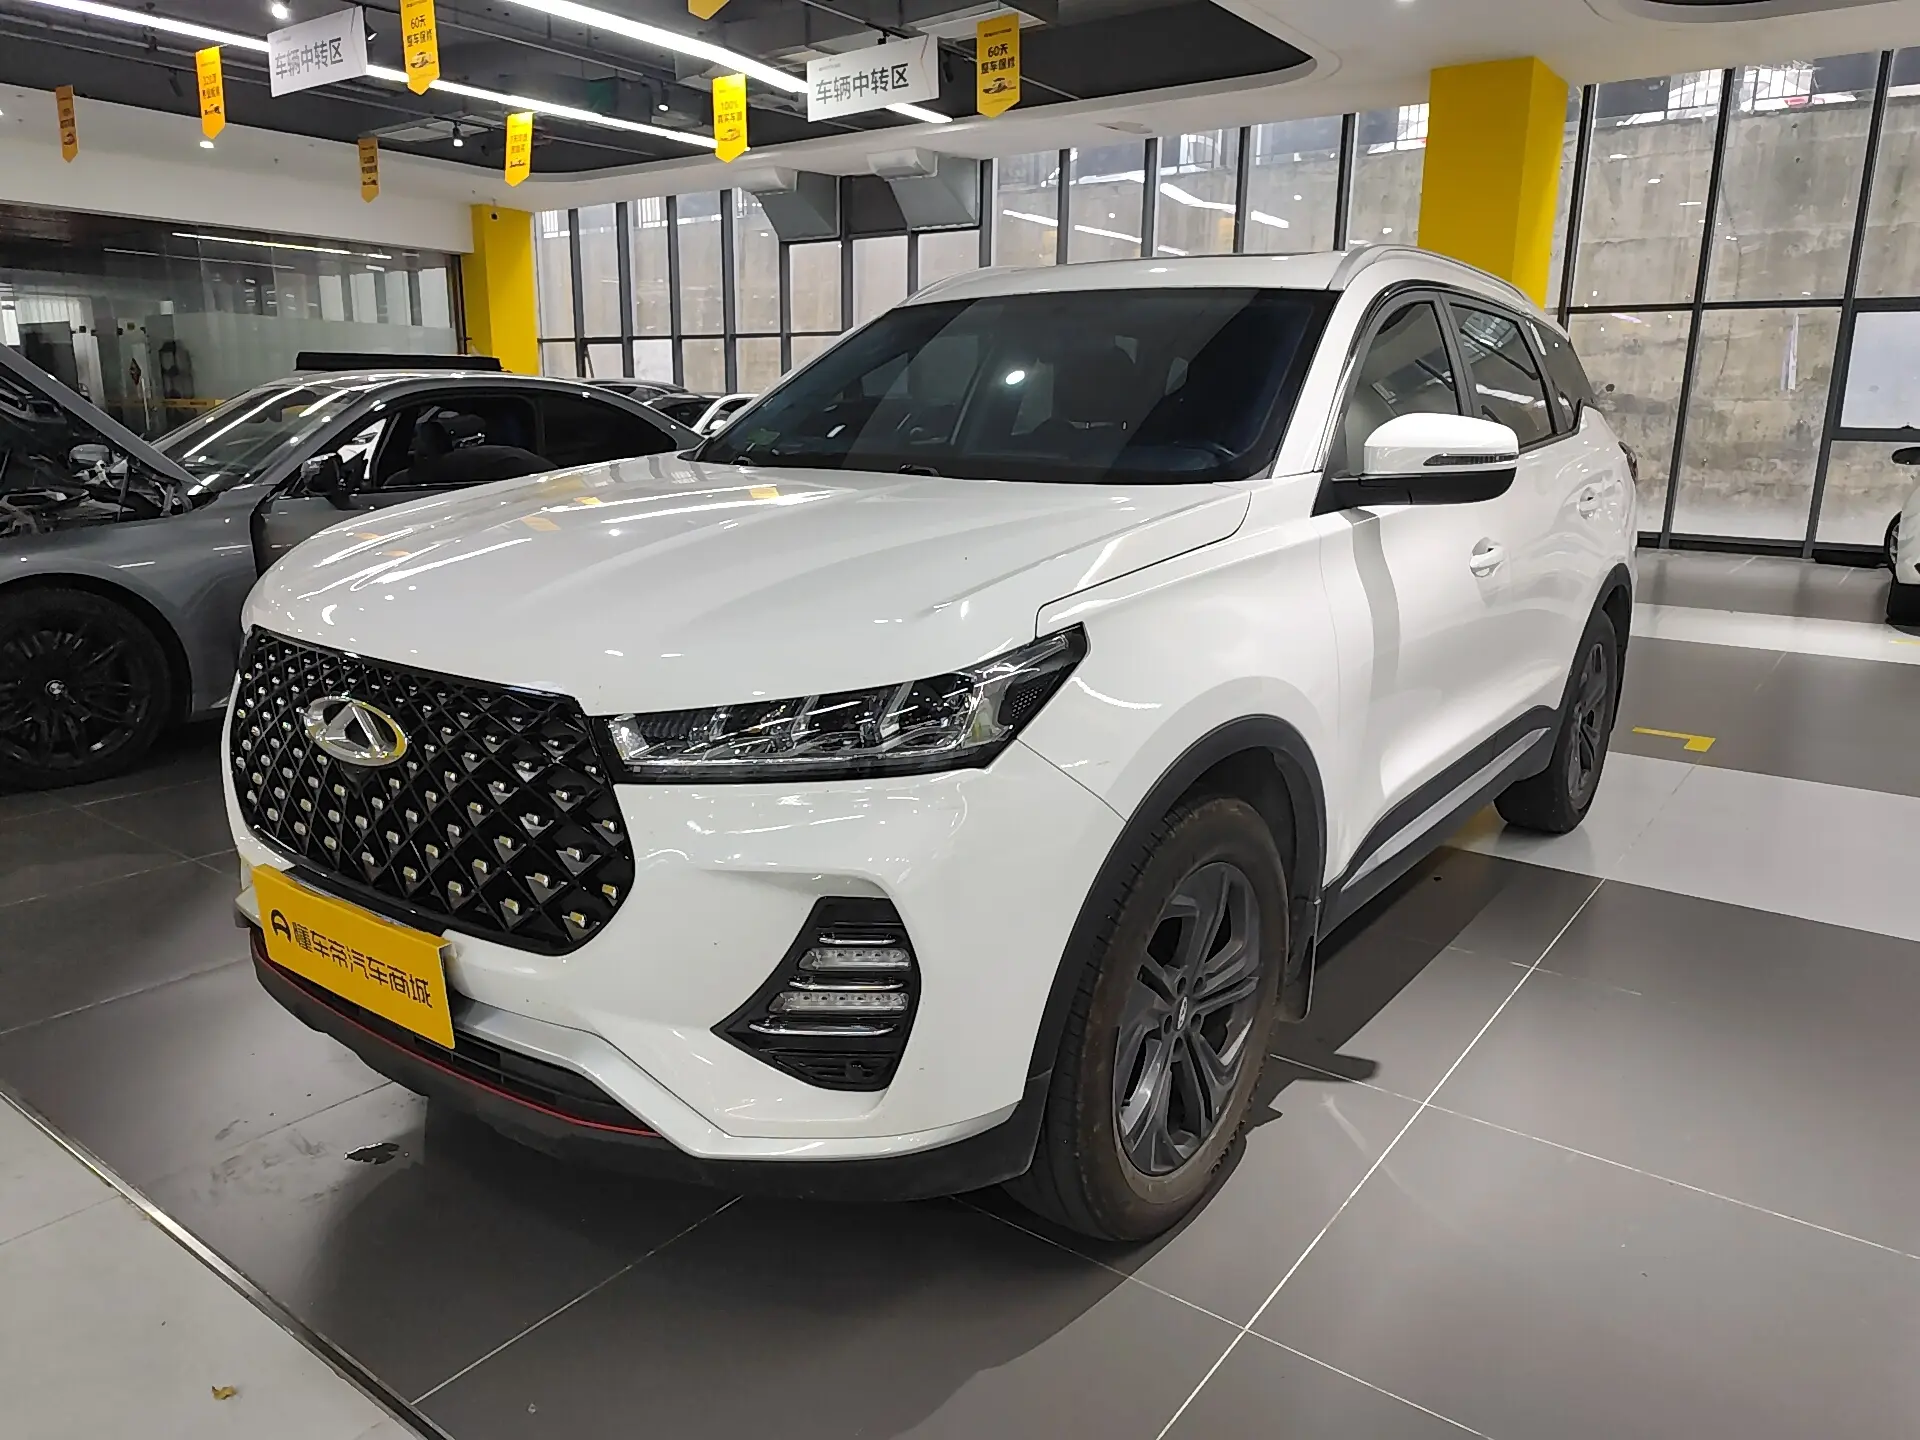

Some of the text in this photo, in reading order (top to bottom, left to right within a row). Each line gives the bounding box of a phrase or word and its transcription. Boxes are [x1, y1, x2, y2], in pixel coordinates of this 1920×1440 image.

[410, 14, 426, 30] 60天
[275, 36, 344, 80] 车辆中转区
[987, 43, 1009, 58] 60天
[815, 63, 909, 104] 车辆中转区
[292, 921, 433, 1008] 懂车帝汽车商城
